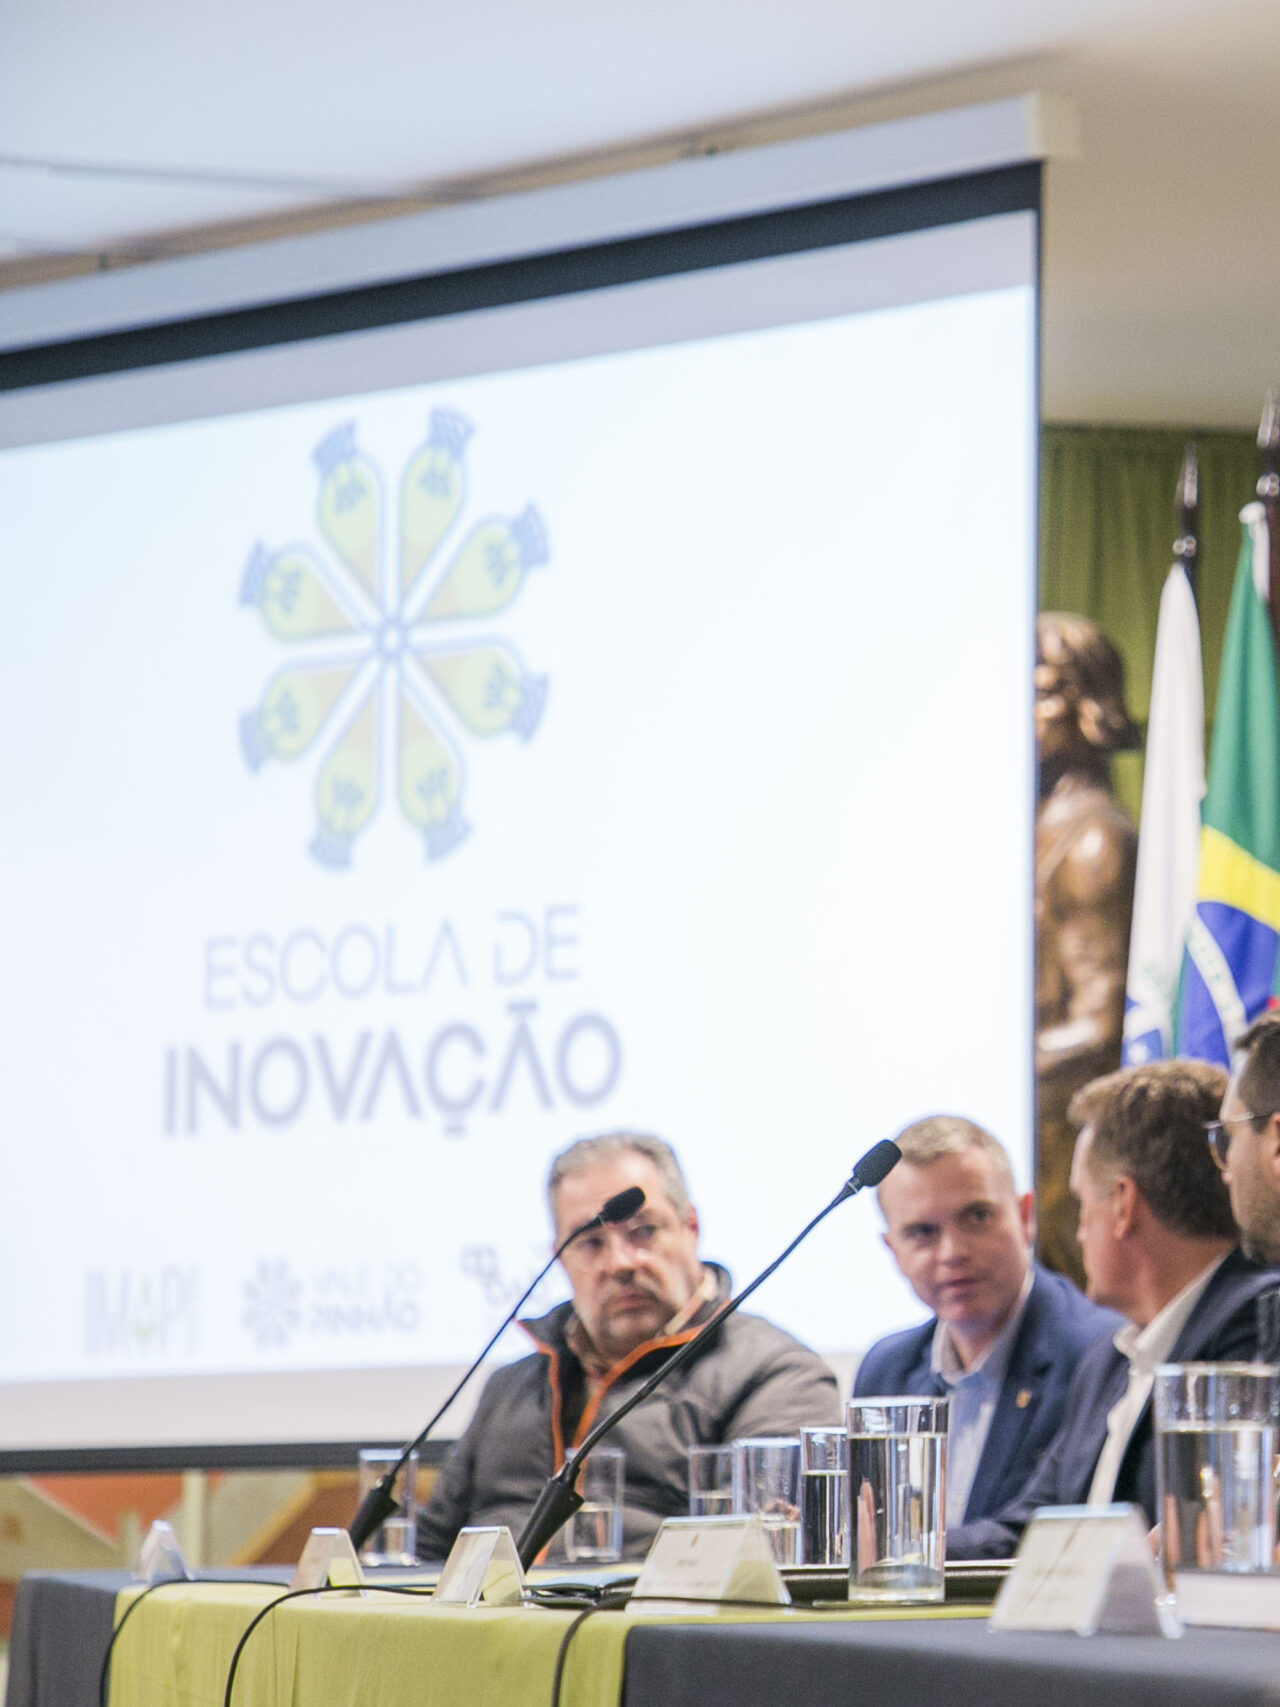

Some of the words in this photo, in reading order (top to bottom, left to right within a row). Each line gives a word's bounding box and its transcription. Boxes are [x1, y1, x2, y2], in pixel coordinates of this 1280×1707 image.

[203, 916, 470, 1012] ESCOLA
[493, 904, 582, 988] DE
[163, 1000, 624, 1138] INOVAÇÃO
